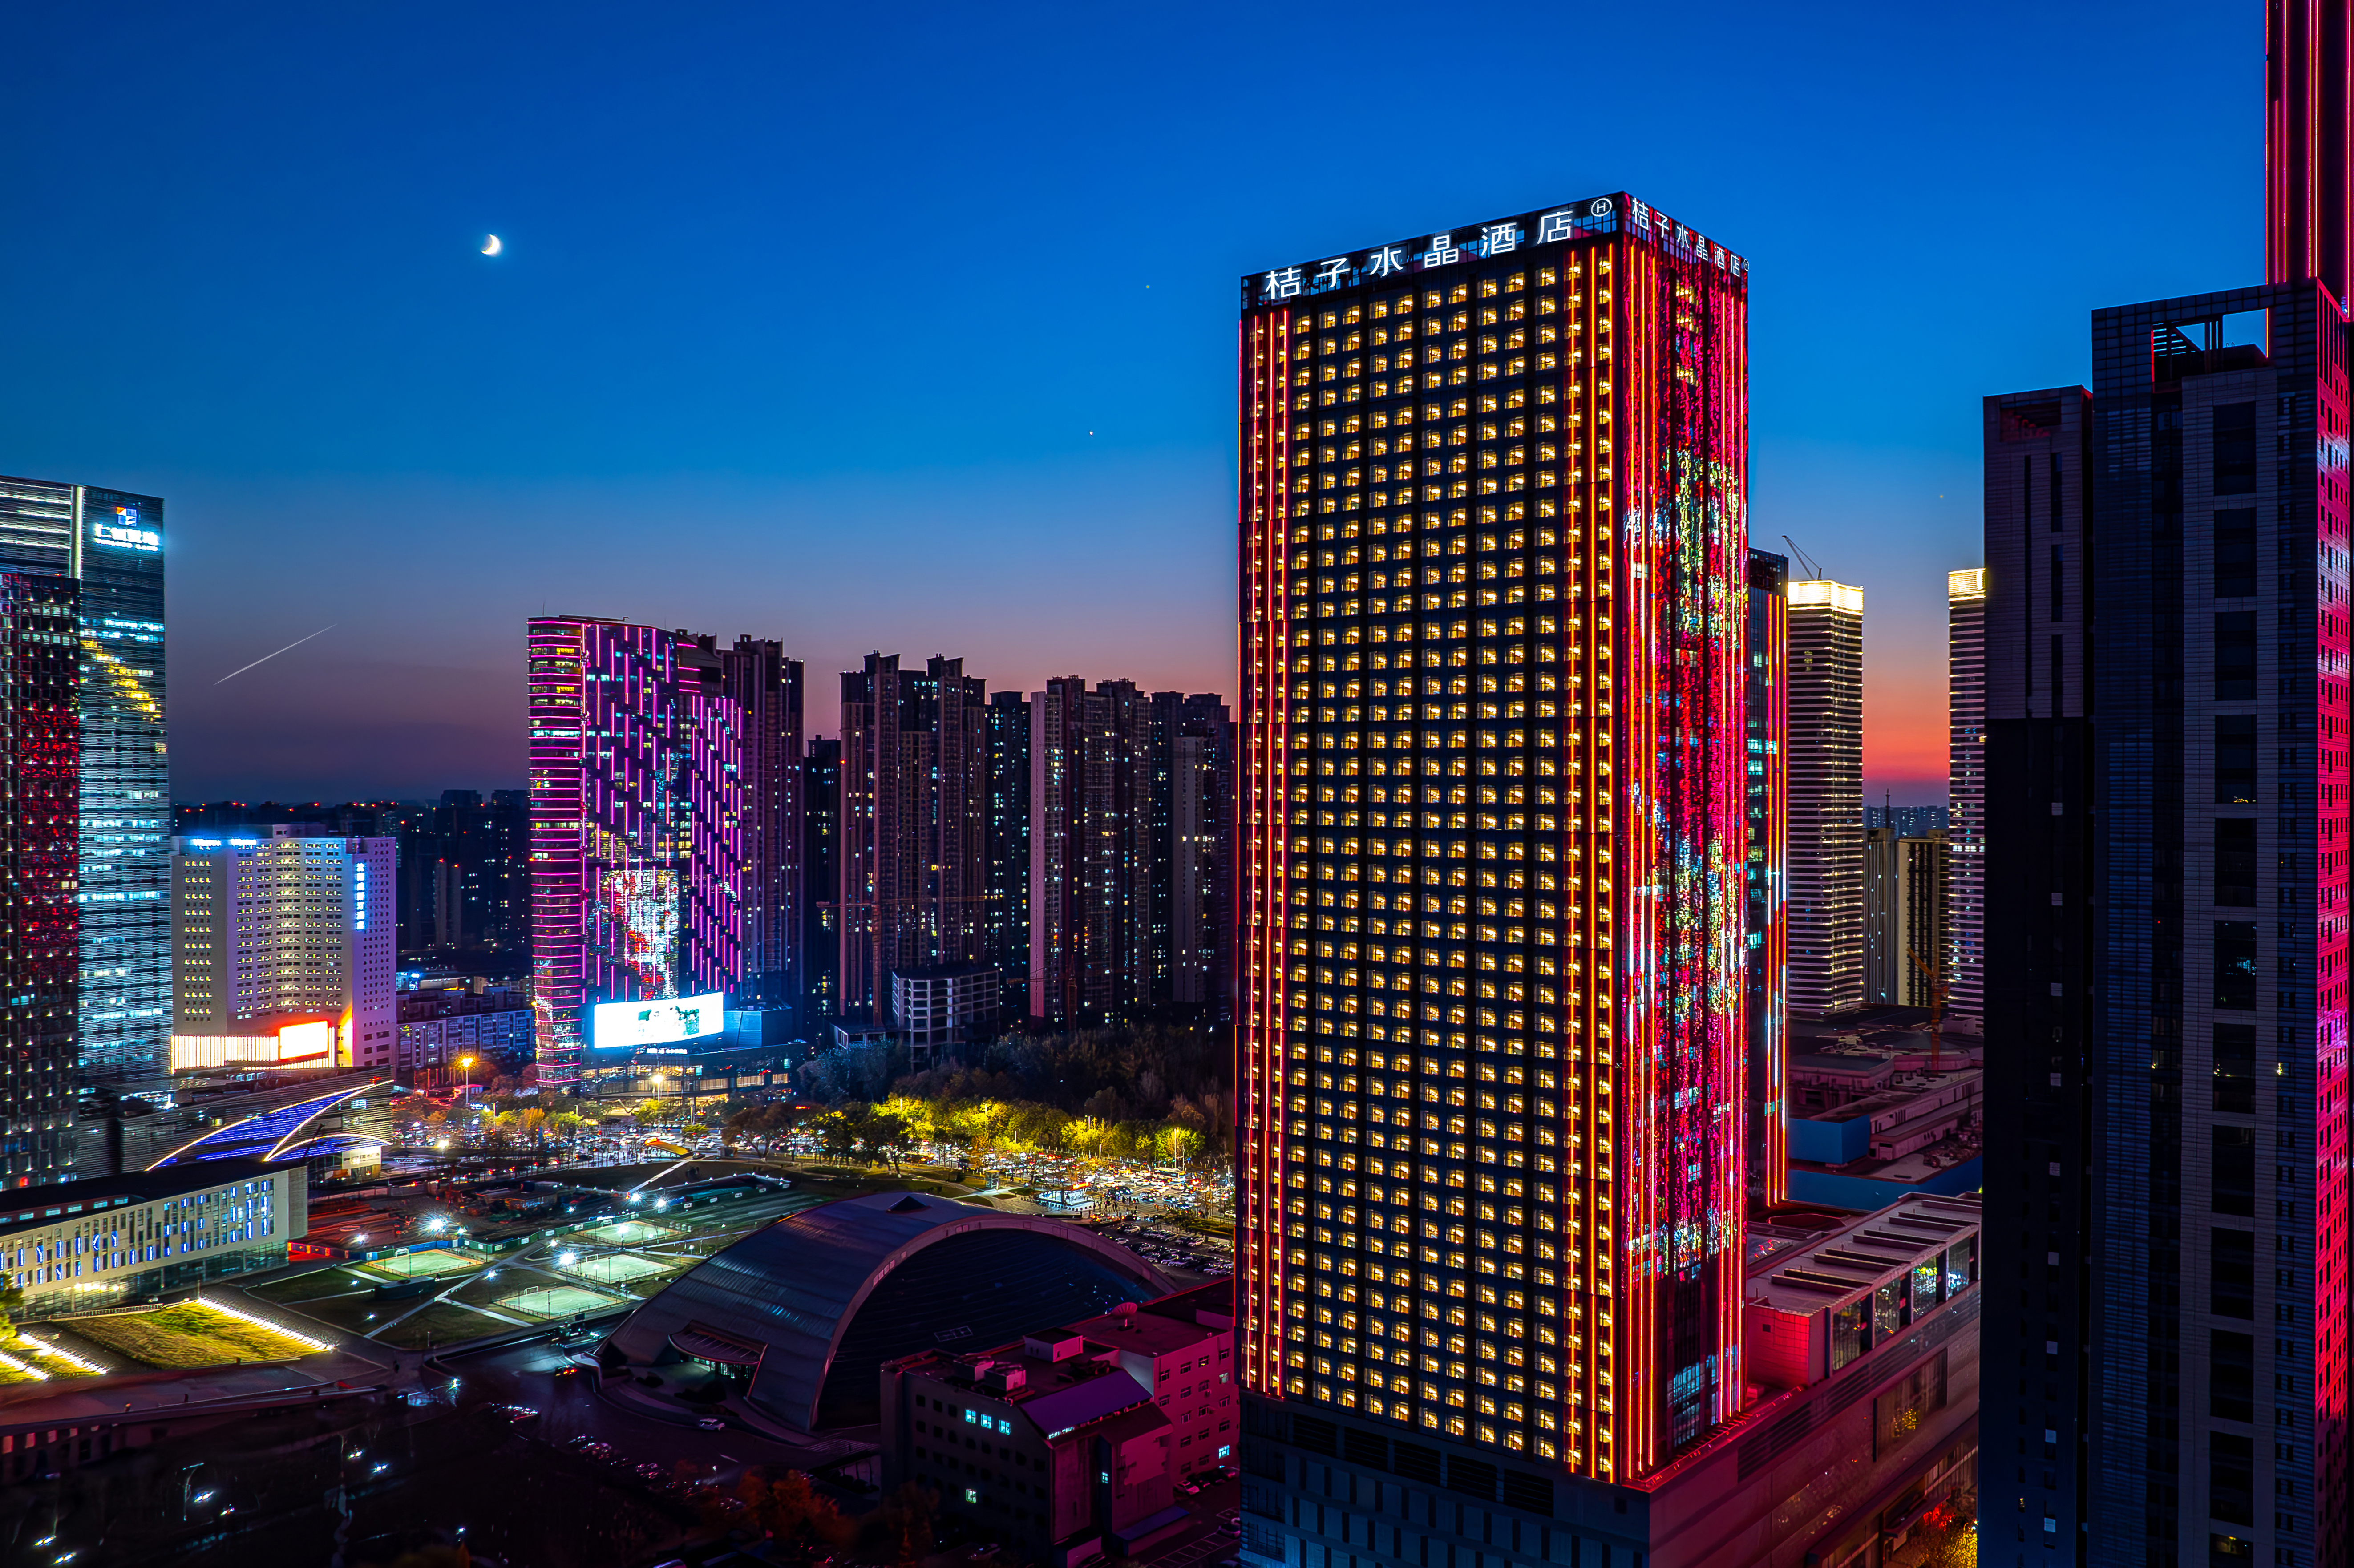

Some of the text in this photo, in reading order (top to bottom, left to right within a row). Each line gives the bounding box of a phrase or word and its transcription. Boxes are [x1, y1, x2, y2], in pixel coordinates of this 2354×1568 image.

[1266, 211, 1573, 300] 桔子水晶酒店
[1632, 197, 1740, 277] 桔子水晶酒店
